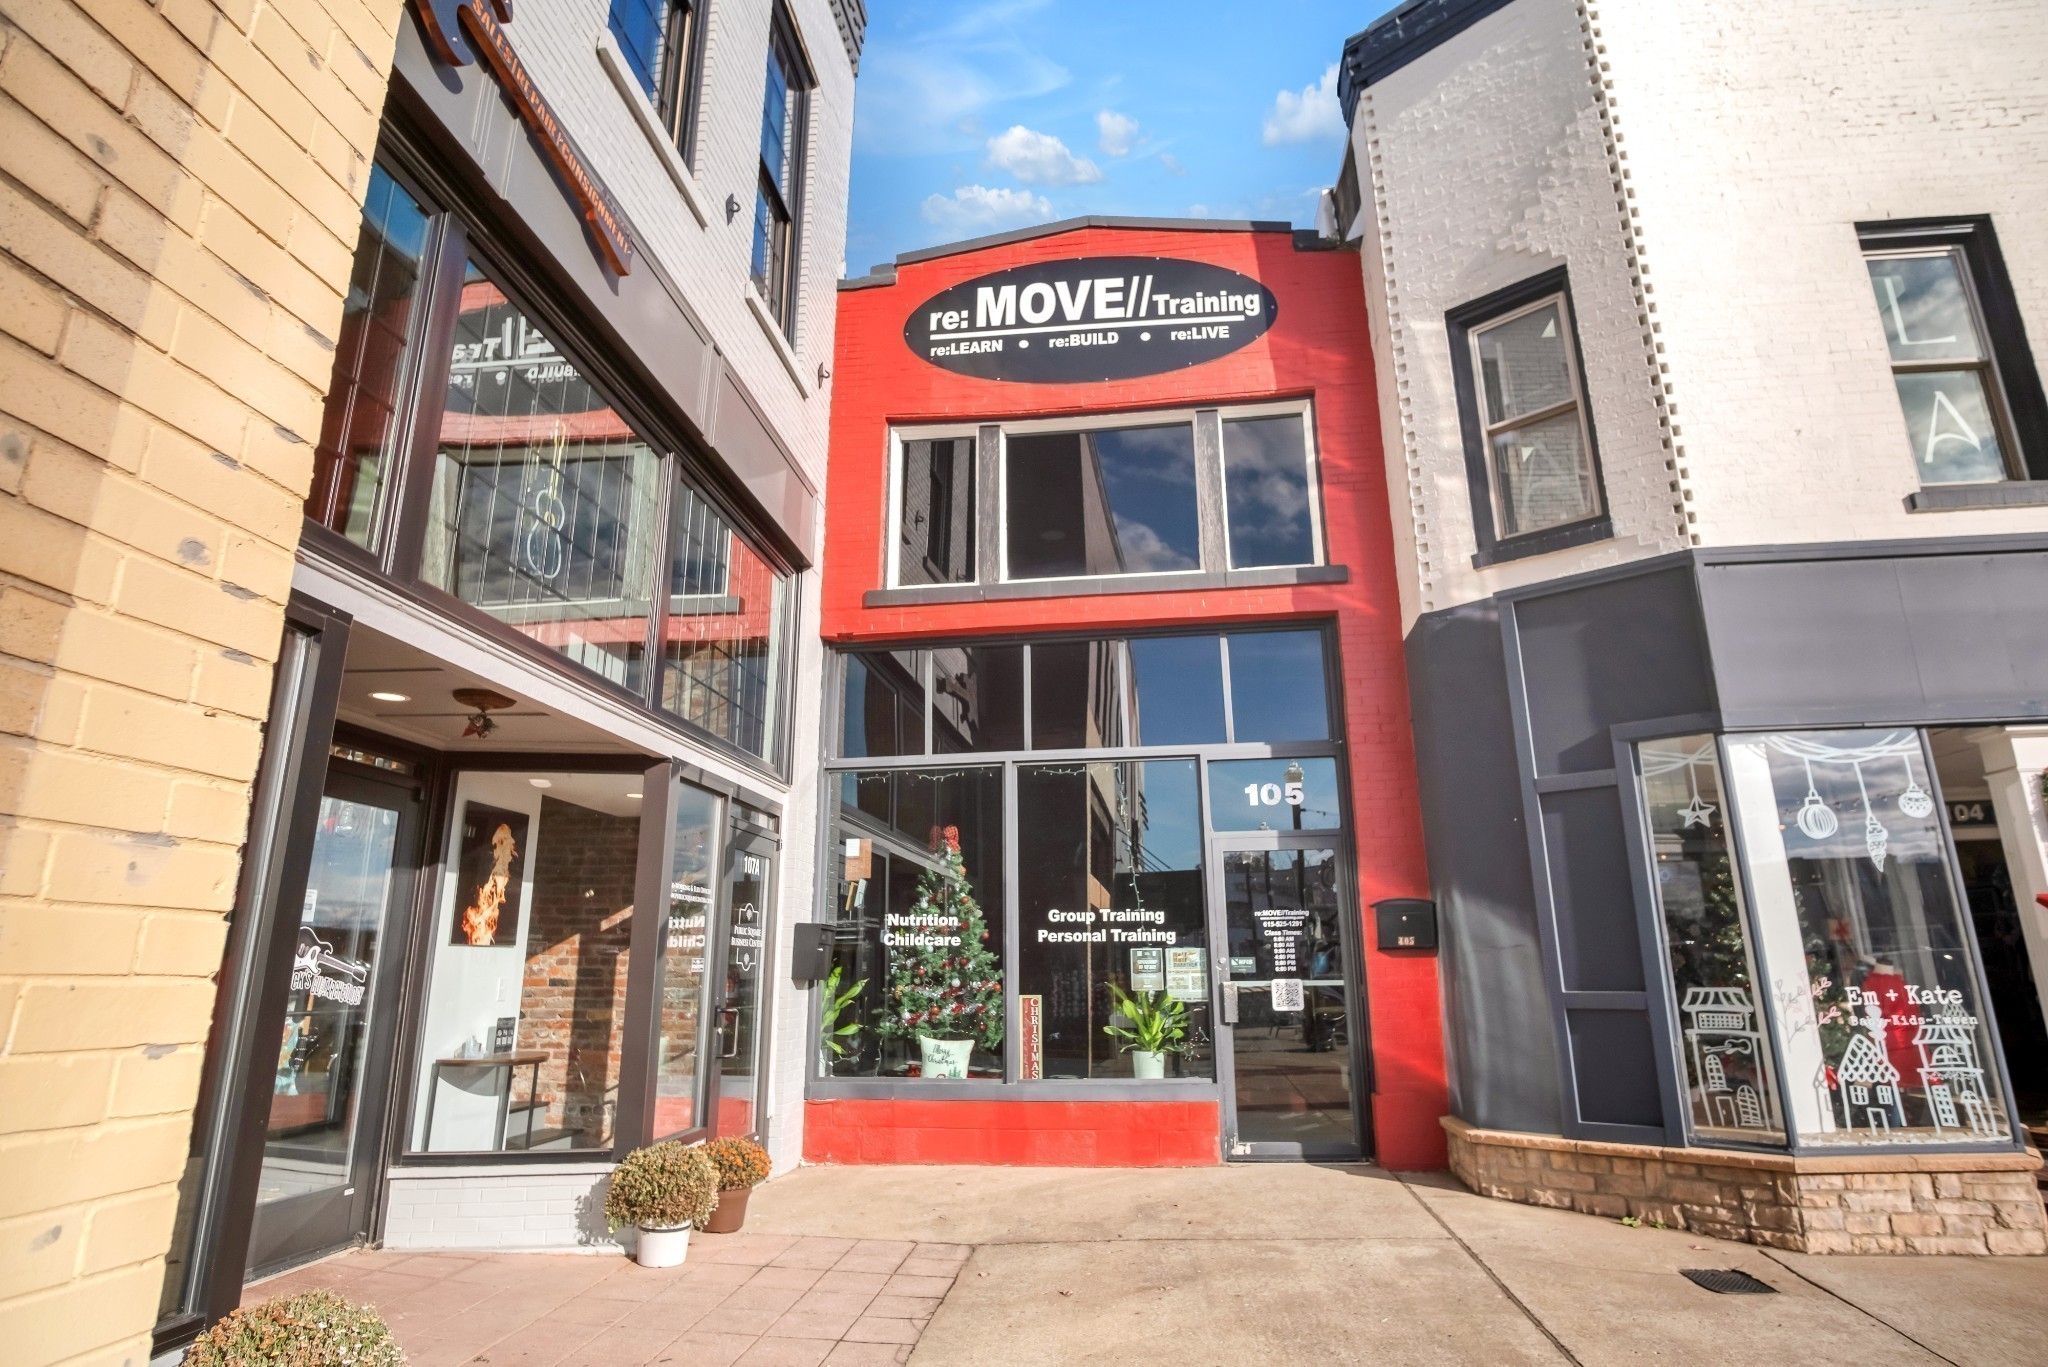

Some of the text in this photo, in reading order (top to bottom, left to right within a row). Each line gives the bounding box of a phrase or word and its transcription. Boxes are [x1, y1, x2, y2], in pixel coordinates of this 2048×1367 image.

[930, 308, 968, 331] re:
[1152, 291, 1260, 316] Training
[930, 326, 1229, 356] re:LEARN re:BUILD re:LIVE
[1244, 782, 1305, 806] 105
[744, 856, 759, 875] 107A
[888, 913, 959, 927] Nutrition
[1048, 909, 1165, 925] Group Training
[884, 934, 961, 947] Childcare
[1038, 929, 1176, 944] Personal Training
[1844, 985, 1963, 1006] Em + Kate
[1030, 998, 1039, 1079] CHRISTMAS
